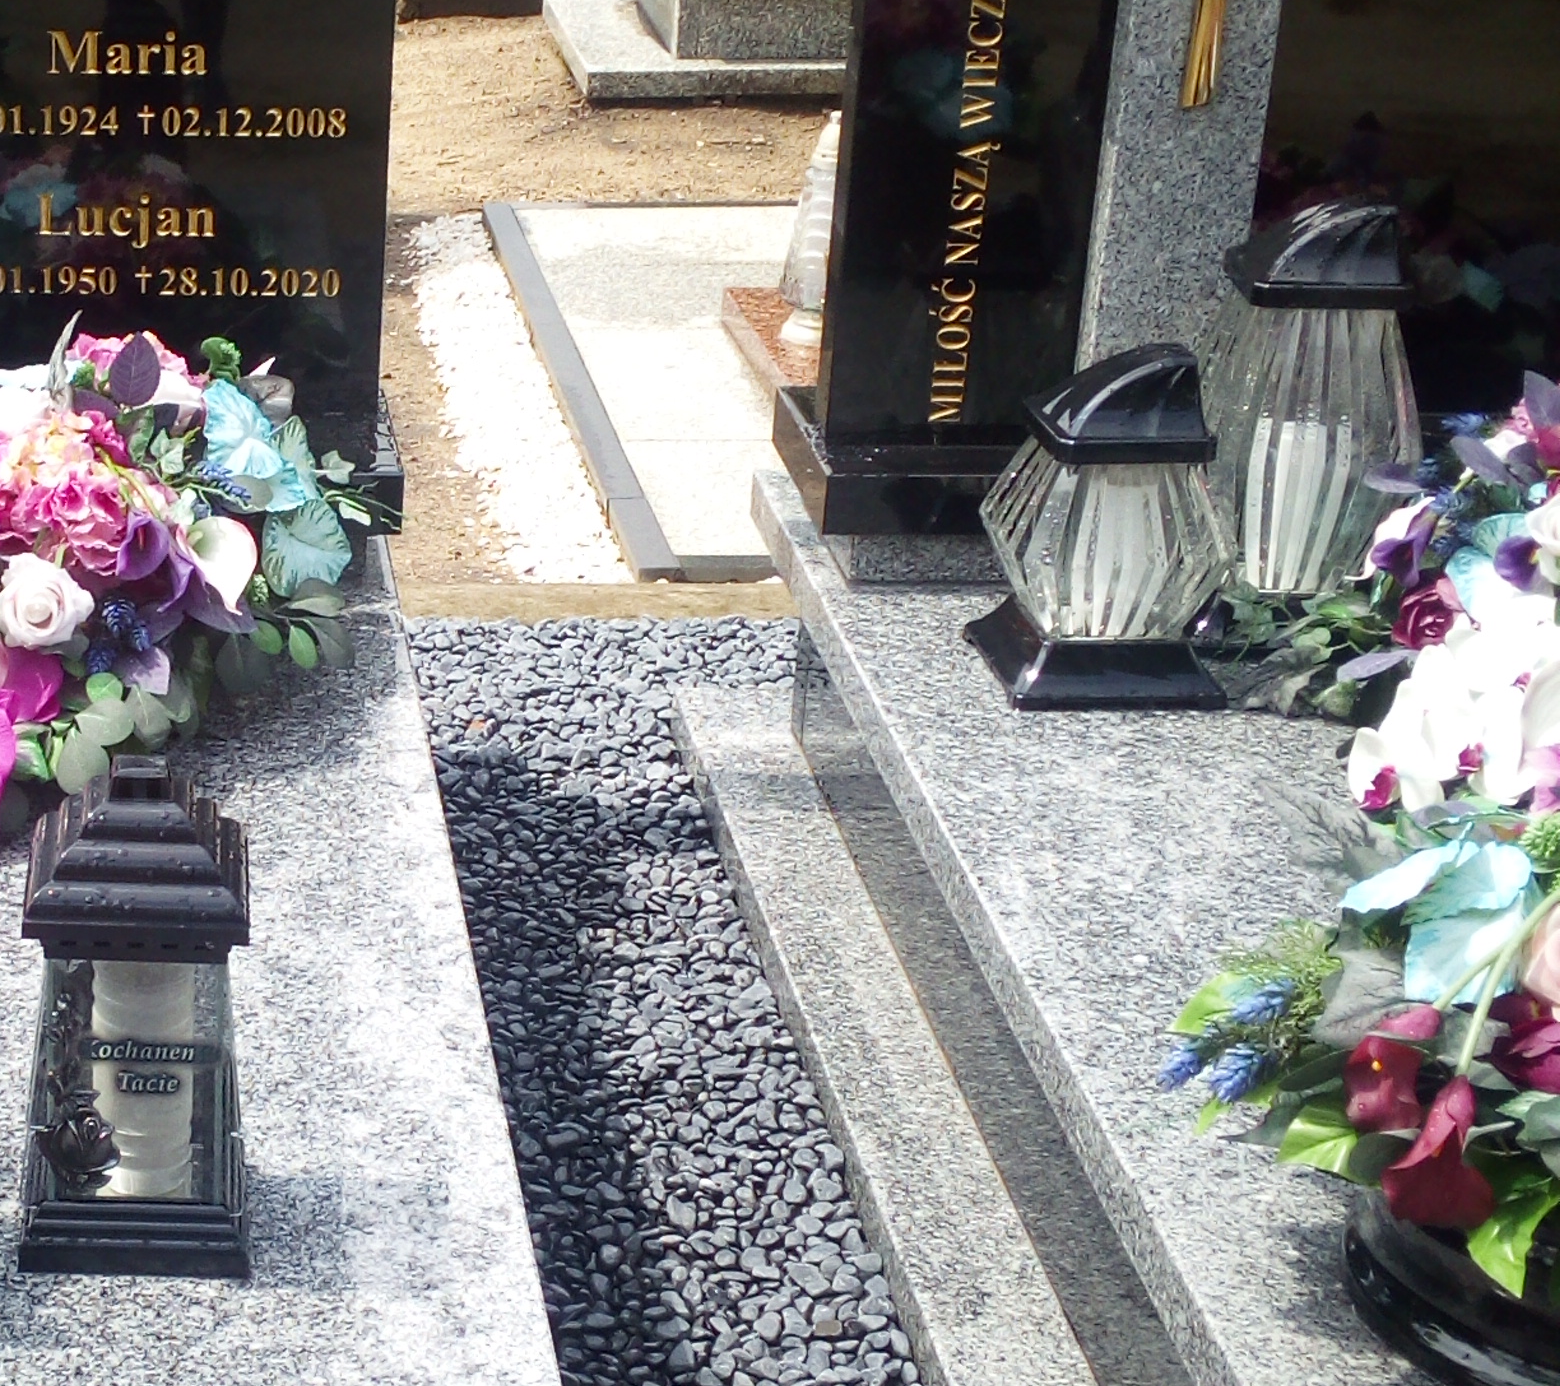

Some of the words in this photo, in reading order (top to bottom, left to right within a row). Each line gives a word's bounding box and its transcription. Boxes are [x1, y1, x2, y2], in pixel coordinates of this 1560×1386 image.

[47, 30, 207, 75] Maria
[162, 107, 347, 138] 02.12.2008
[37, 192, 216, 248] Lucjan
[944, 141, 1002, 266] NASZĄ
[159, 267, 341, 298] 28.10.2020
[927, 277, 977, 422] MIŁOŚĆ
[118, 1071, 179, 1092] Tacie
